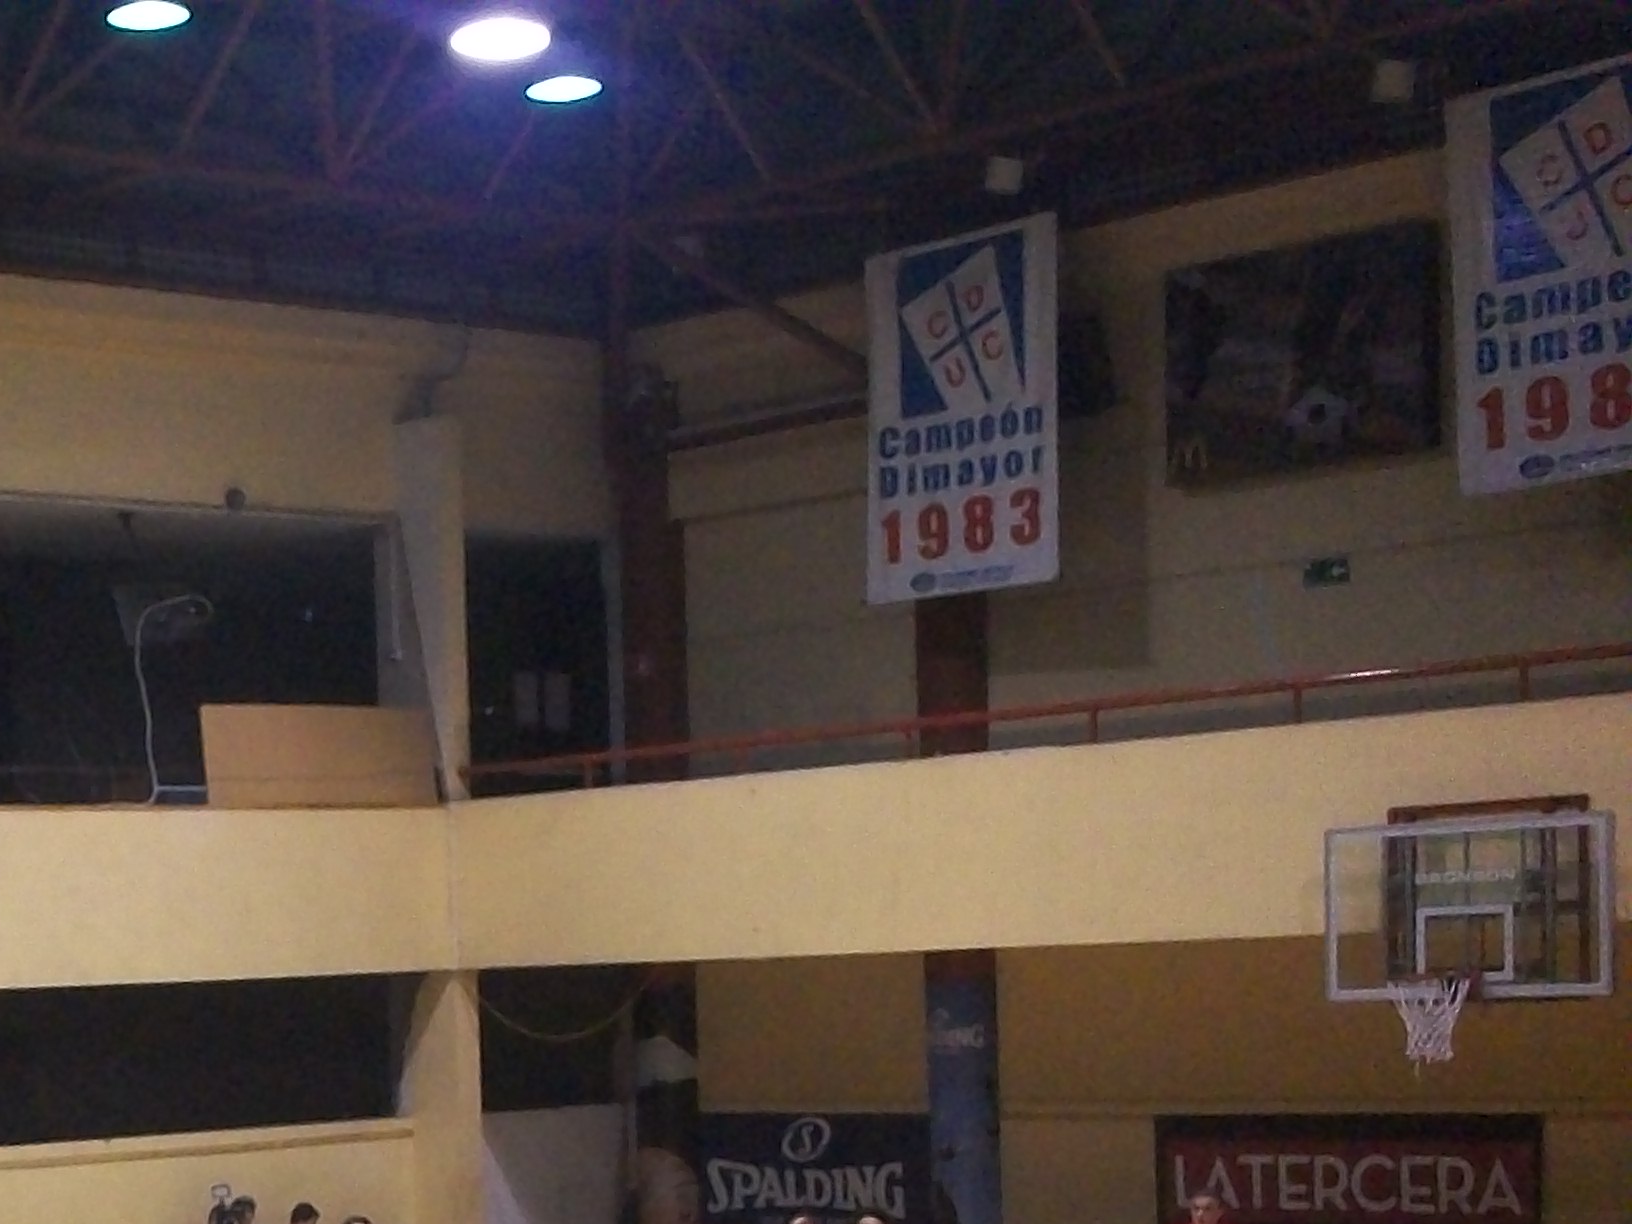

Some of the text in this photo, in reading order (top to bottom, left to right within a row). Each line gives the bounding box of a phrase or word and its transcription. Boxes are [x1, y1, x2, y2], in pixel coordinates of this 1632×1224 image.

[879, 402, 1044, 459] Campeón
[1477, 362, 1632, 450] 198
[879, 444, 1046, 499] Dimayor
[881, 487, 1041, 564] 1983
[706, 1158, 905, 1219] SPALDING
